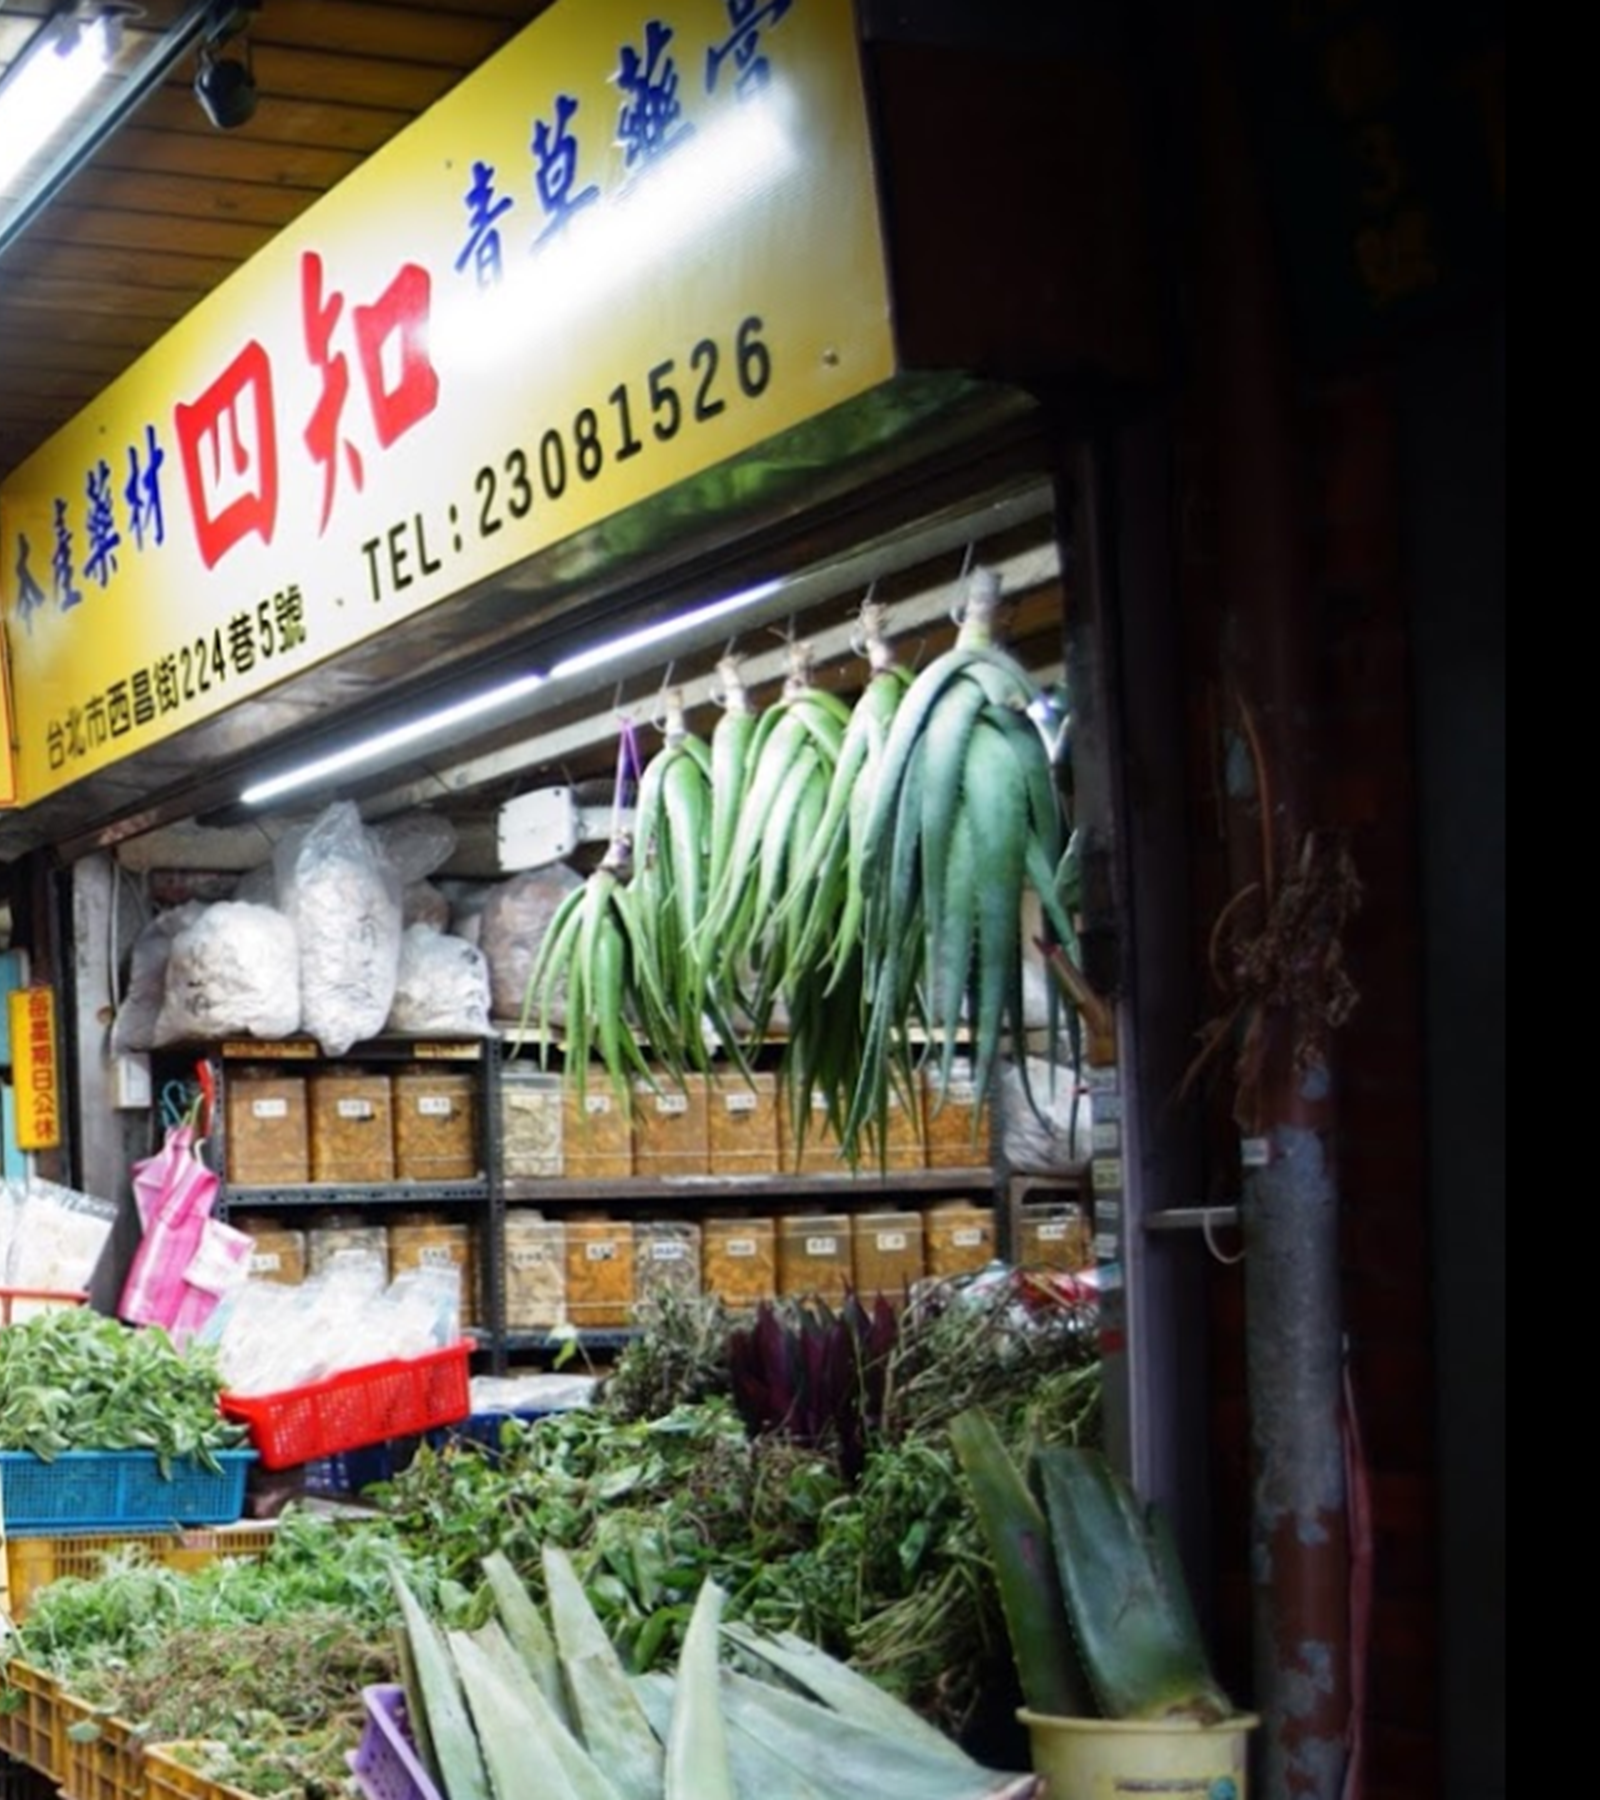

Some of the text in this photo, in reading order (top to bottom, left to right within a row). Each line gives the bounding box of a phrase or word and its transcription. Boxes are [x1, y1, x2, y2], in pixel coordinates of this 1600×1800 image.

[174, 250, 439, 571] 四知
[361, 316, 772, 603] TEL:23081526
[46, 583, 306, 771] 台北市西昌街224巷5號
